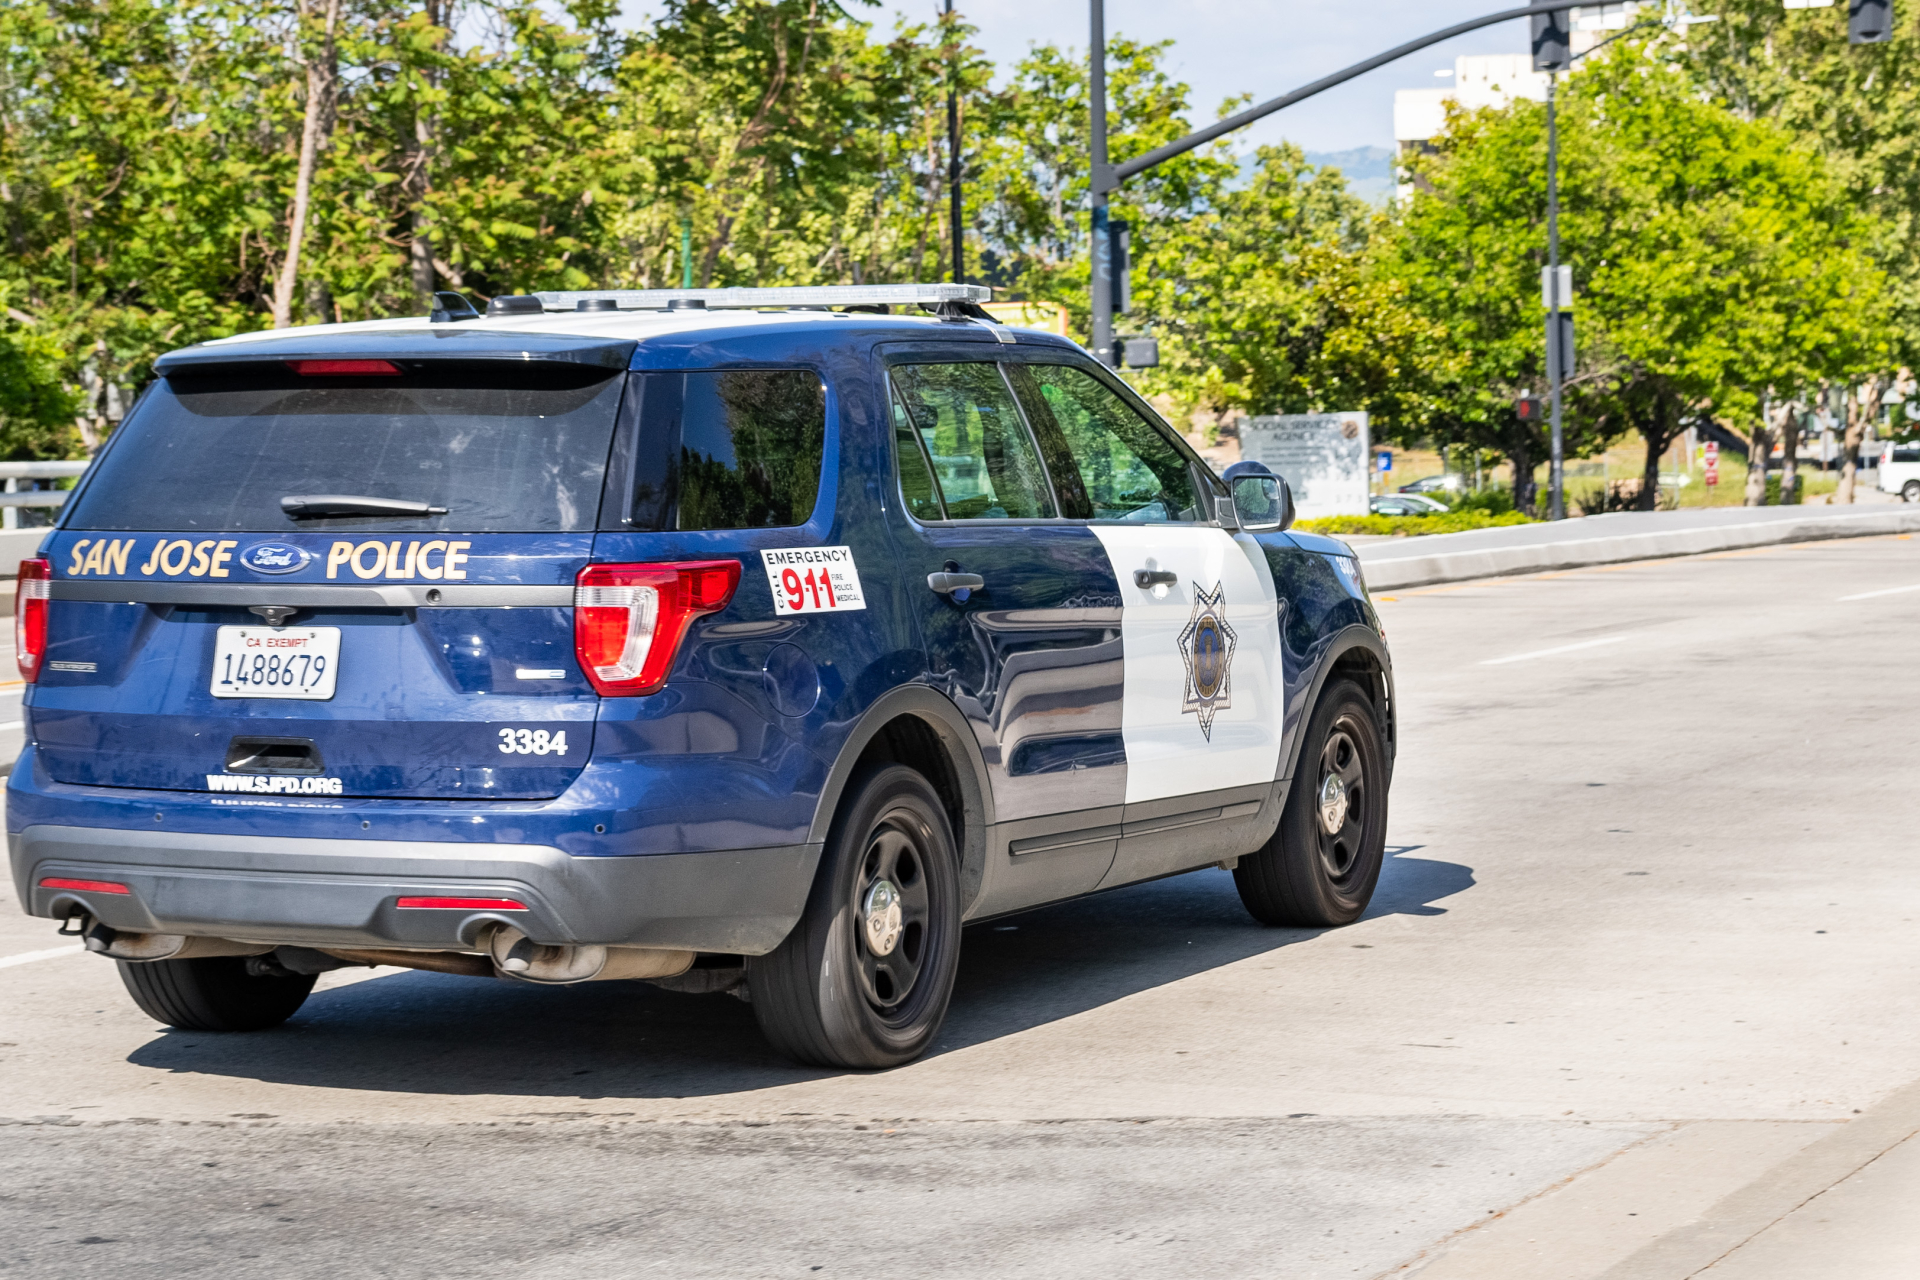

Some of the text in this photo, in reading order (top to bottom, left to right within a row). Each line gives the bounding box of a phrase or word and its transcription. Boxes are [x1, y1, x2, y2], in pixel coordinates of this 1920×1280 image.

[67, 539, 472, 580] SAN JOSE POLICE
[253, 547, 293, 567] Ford
[766, 550, 848, 565] EMERGENCY
[772, 571, 784, 609] CALL
[836, 594, 860, 602] MEDICAL
[246, 638, 308, 648] CA EXEMPT
[221, 653, 326, 687] 1488679
[498, 728, 568, 756] 3384
[206, 774, 343, 794] WWW.SJPD.ORG
